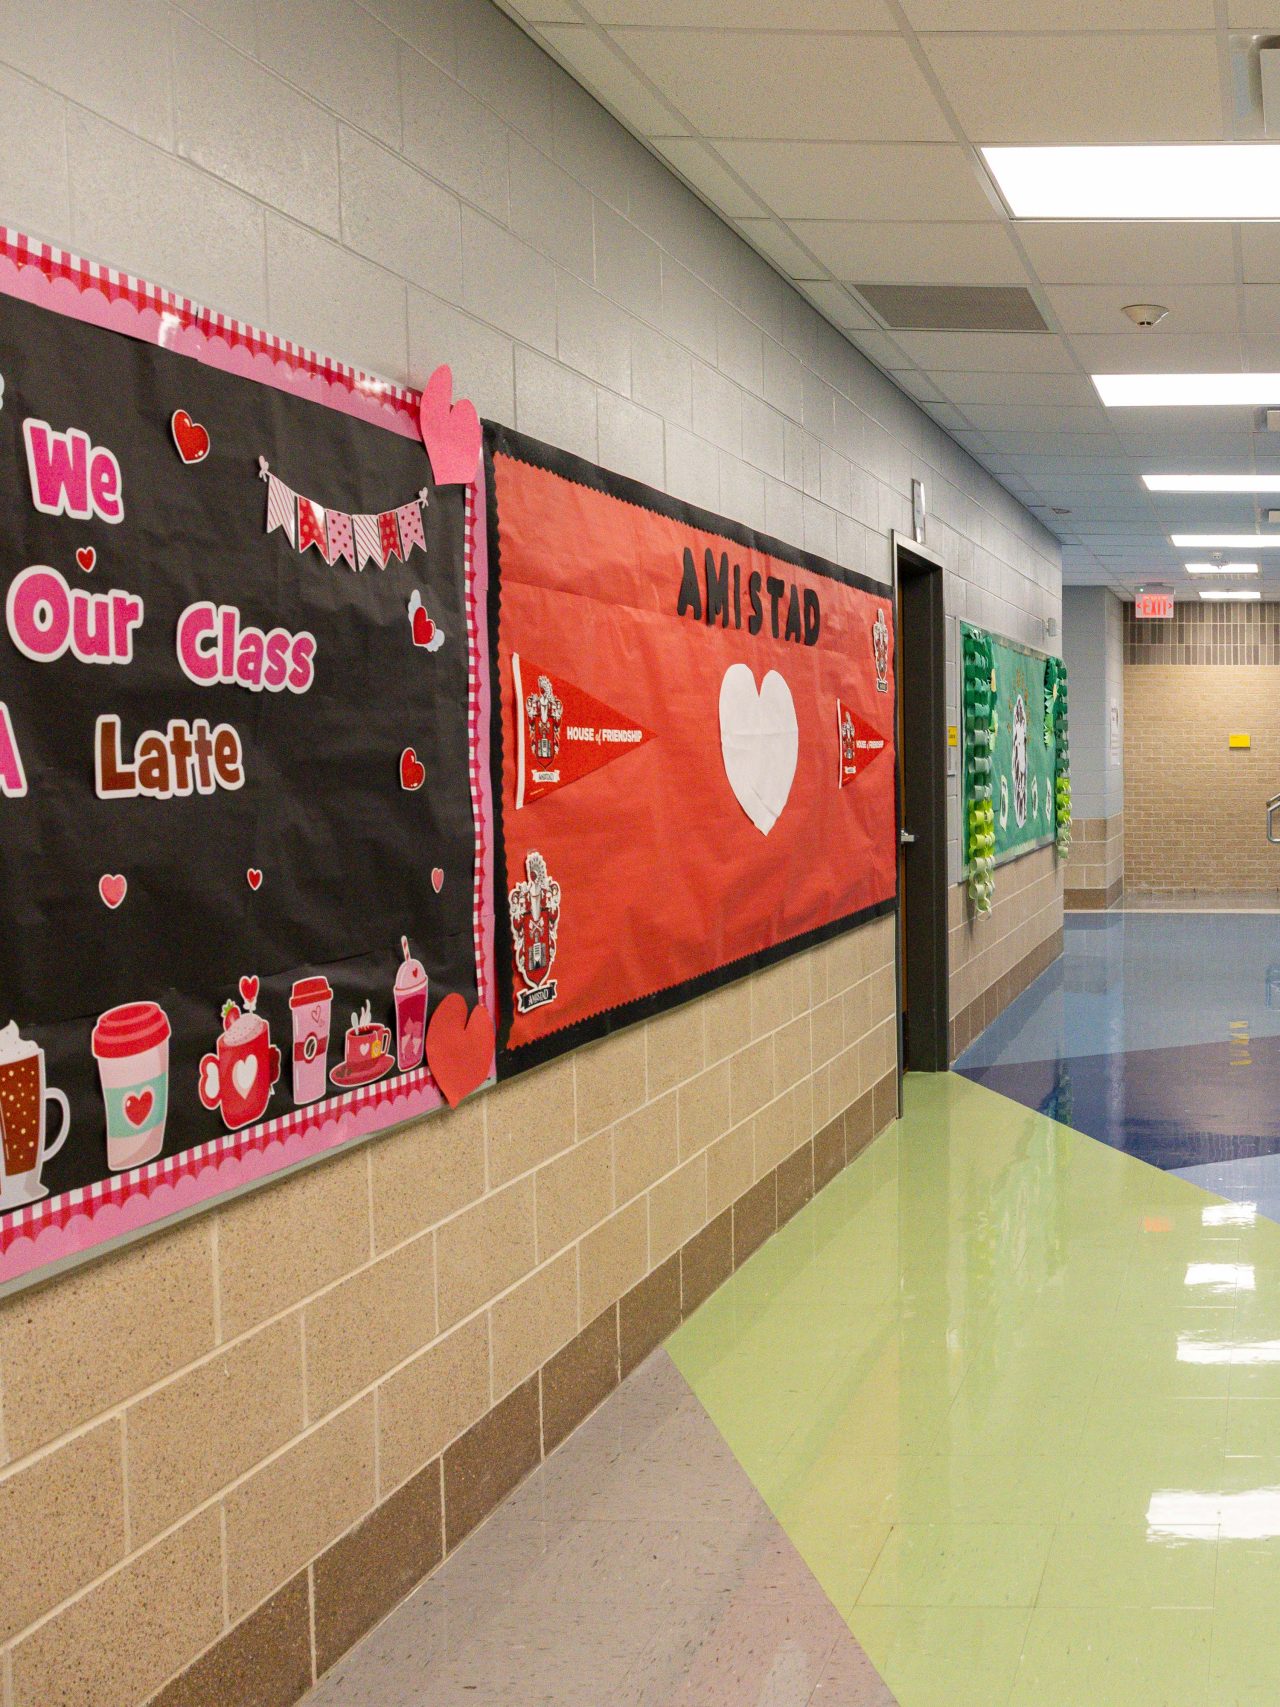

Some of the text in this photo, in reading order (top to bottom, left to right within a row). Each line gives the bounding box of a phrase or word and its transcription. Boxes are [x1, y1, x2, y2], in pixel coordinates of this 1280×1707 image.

[23, 417, 124, 524] We
[6, 564, 317, 694] Our Class
[677, 547, 820, 646] AMISTAD
[1142, 595, 1168, 616] EXIT
[94, 714, 246, 799] Latte
[566, 726, 595, 741] HOUSE
[602, 728, 643, 743] FRIENDSHIP
